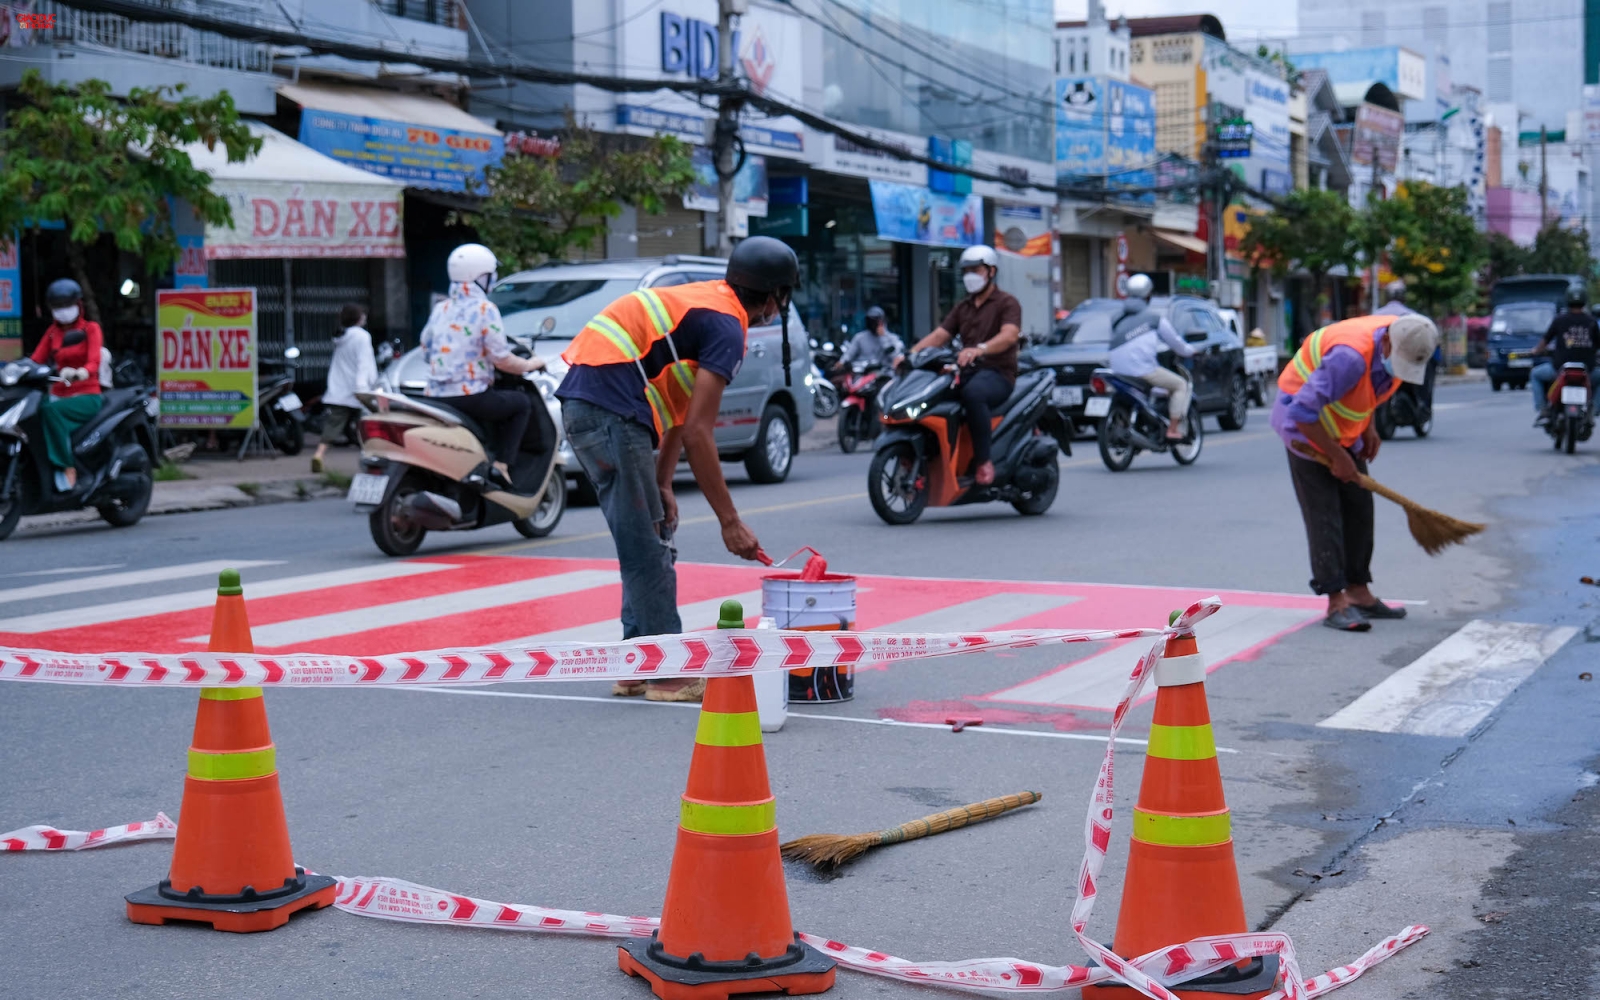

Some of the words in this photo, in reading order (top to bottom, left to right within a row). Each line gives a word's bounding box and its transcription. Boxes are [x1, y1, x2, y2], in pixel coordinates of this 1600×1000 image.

[251, 184, 340, 237] DÁN
[348, 201, 400, 237] XE
[162, 314, 212, 370] DÁN
[218, 328, 251, 370] XE
